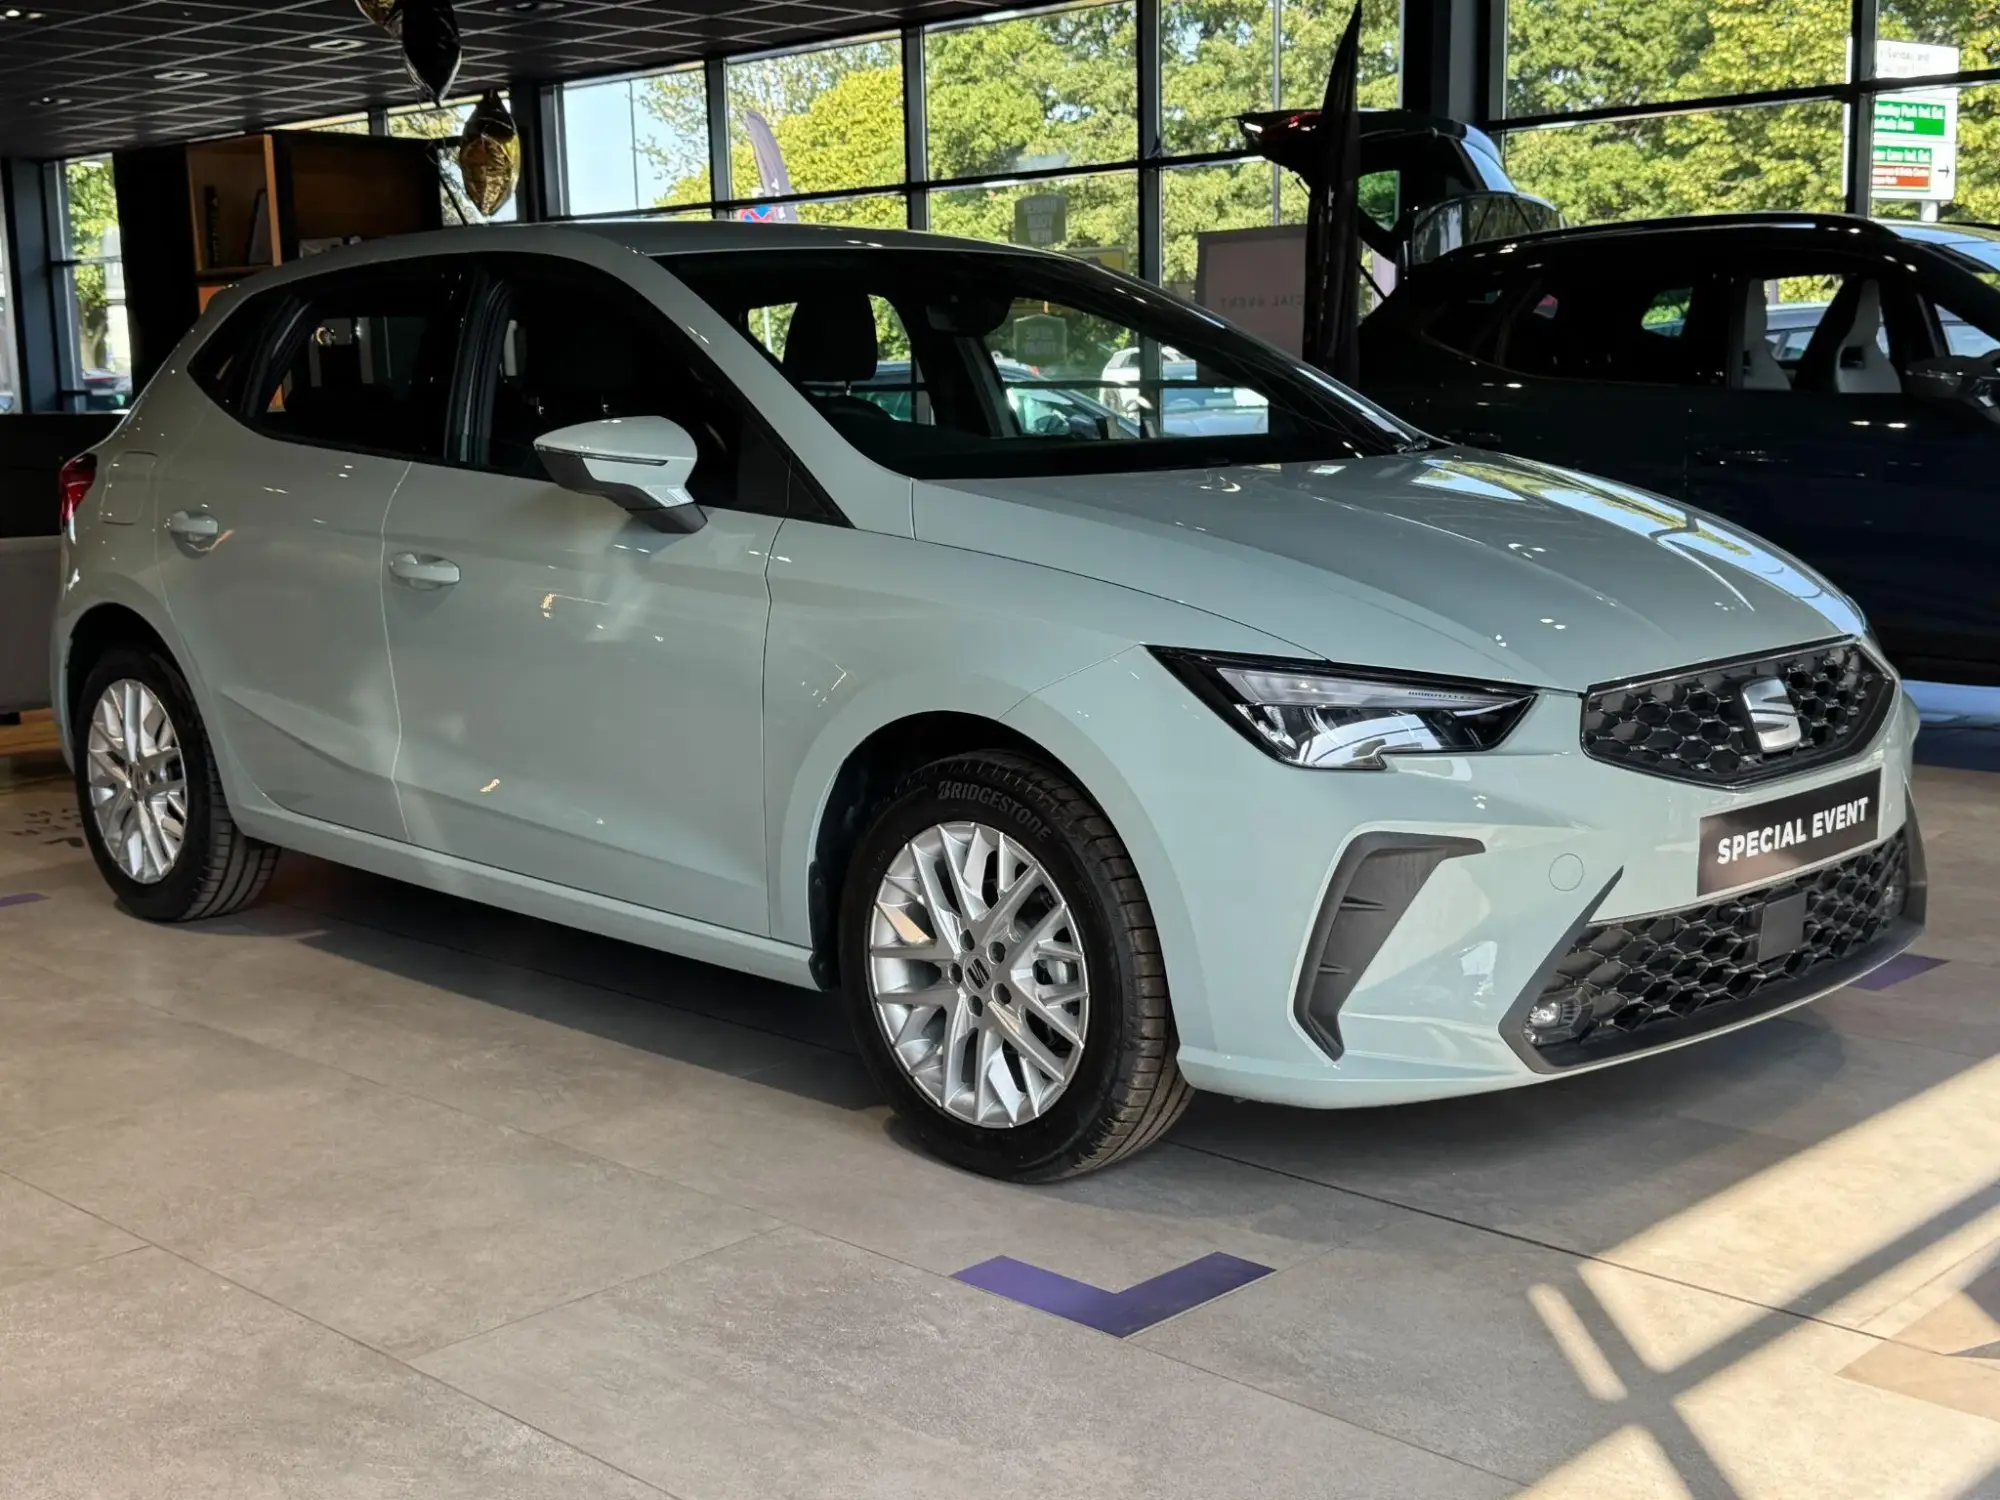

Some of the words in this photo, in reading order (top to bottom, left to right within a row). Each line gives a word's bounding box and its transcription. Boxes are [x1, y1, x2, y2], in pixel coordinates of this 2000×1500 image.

[937, 780, 1053, 843] BRIDGESTONE
[1717, 818, 1807, 865] SPECIAL
[1812, 796, 1869, 839] EVENT
